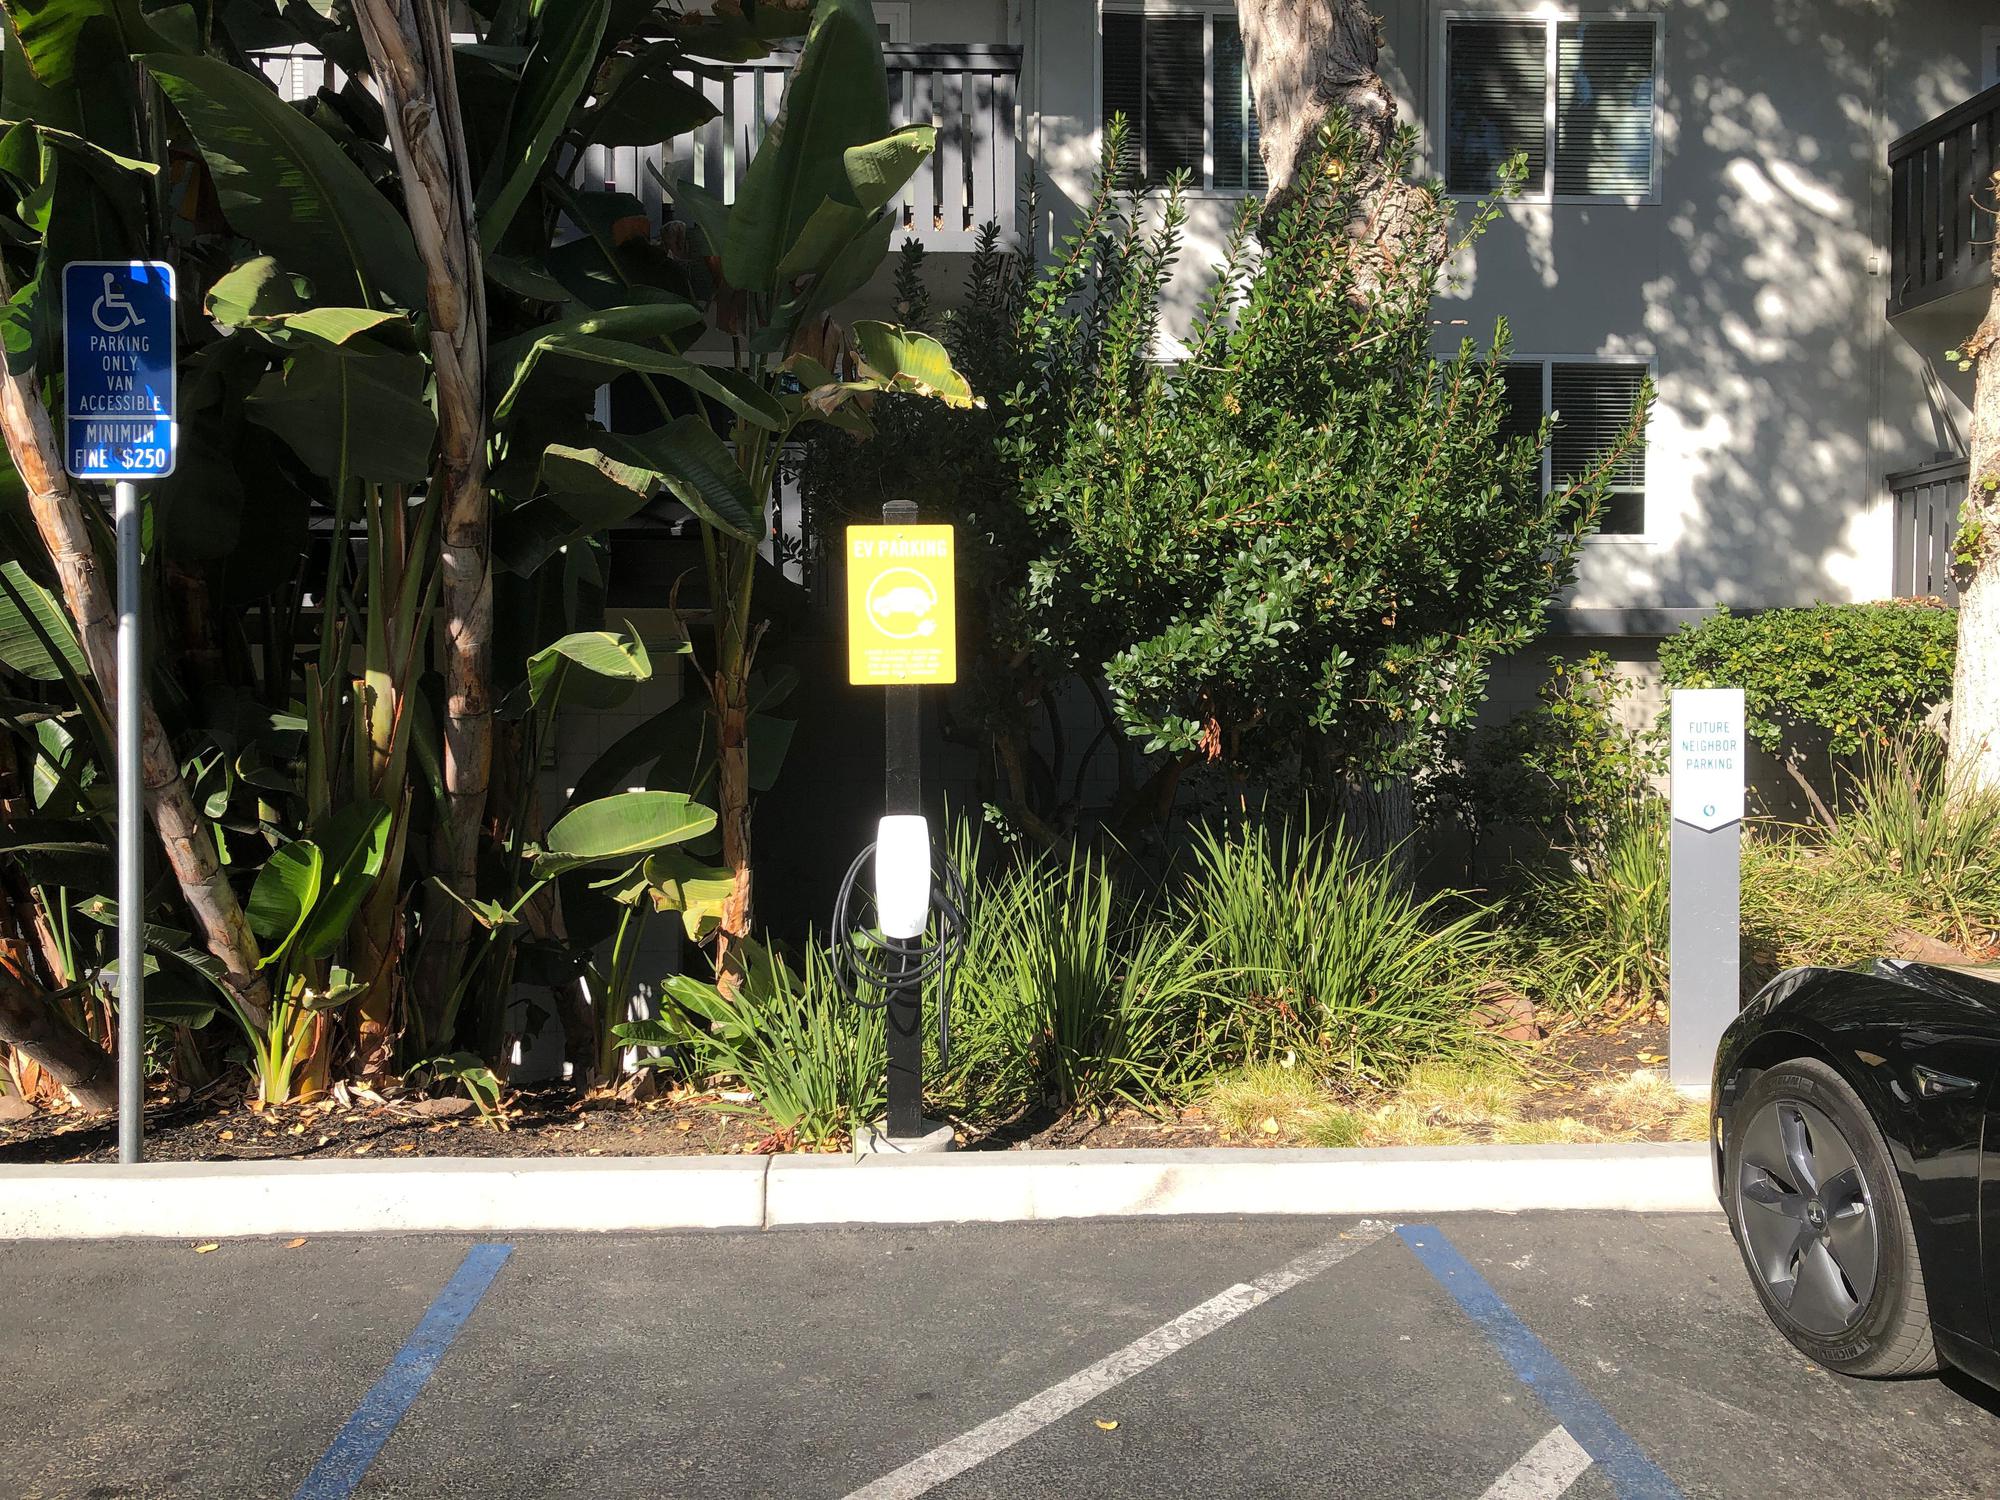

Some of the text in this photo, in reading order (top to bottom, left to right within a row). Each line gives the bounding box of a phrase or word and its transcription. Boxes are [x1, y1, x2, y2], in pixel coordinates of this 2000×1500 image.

[91, 336, 149, 352] PARKING
[106, 375, 133, 391] VAN
[80, 395, 161, 411] ACCESSIBLE
[86, 424, 154, 443] MINIMUM
[75, 447, 165, 470] FINE $250
[854, 540, 947, 558] EV PARKING
[1689, 722, 1730, 733] FUTURE
[1682, 739, 1737, 752] NEIGHBOR
[1686, 758, 1733, 770] PARKING
